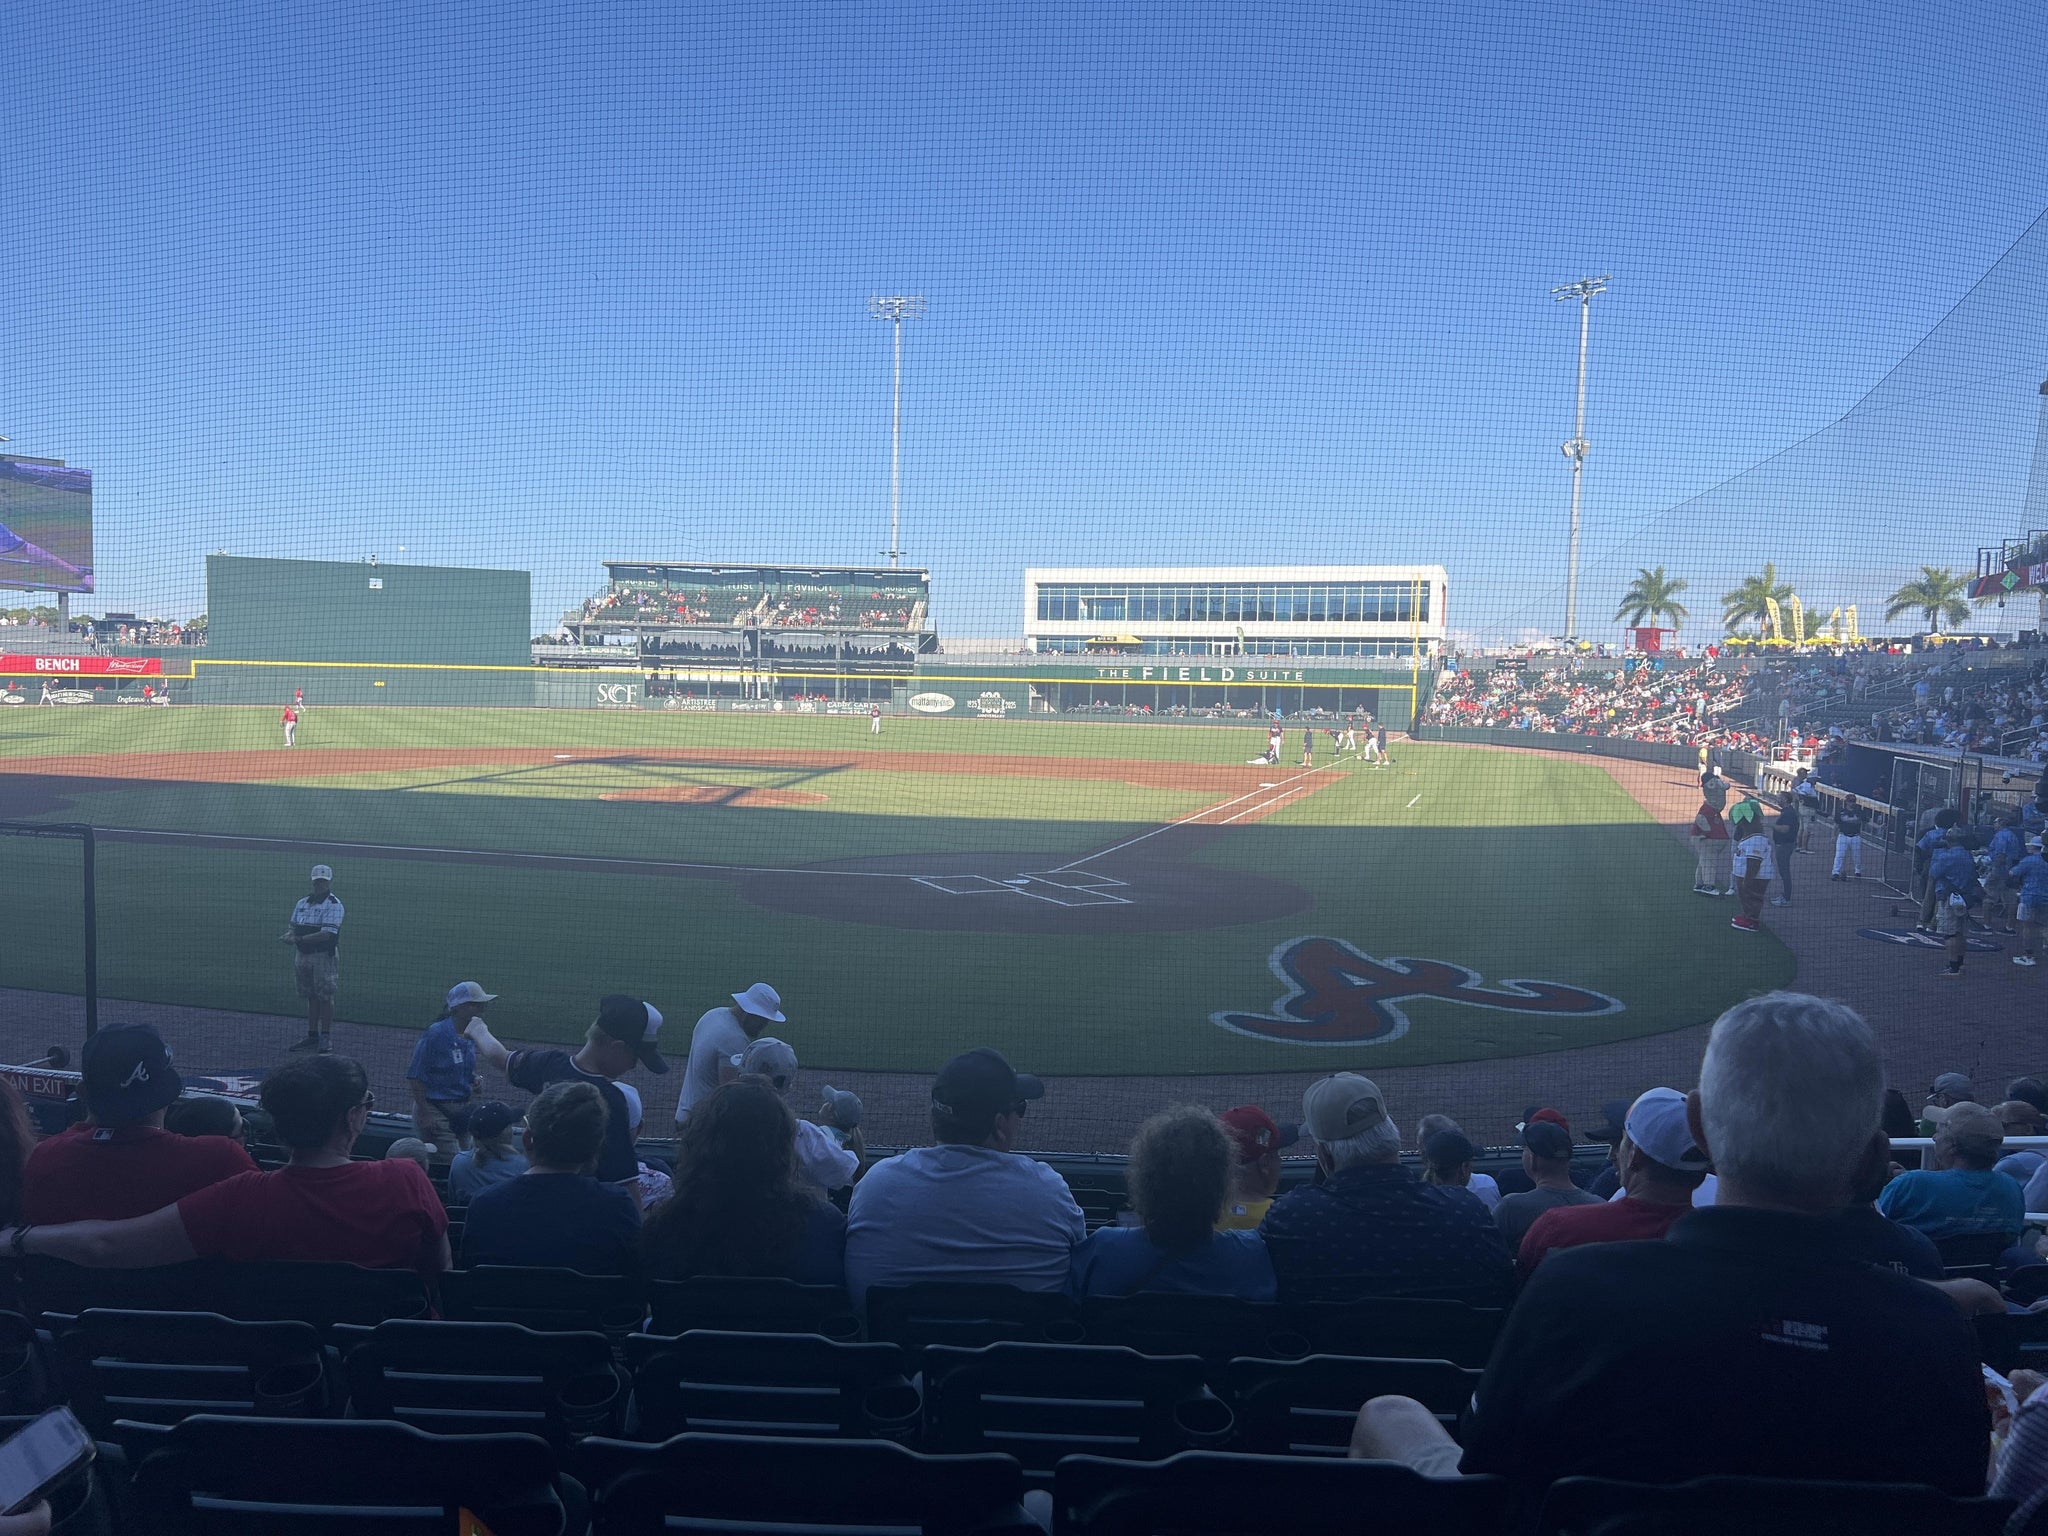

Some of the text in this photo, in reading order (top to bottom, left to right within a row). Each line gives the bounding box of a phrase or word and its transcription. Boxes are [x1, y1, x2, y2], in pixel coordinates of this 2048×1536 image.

[35, 658, 80, 671] BENCH
[1098, 667, 1304, 682] THE FIELD SUITE
[9, 1075, 64, 1095] AN EXIT
